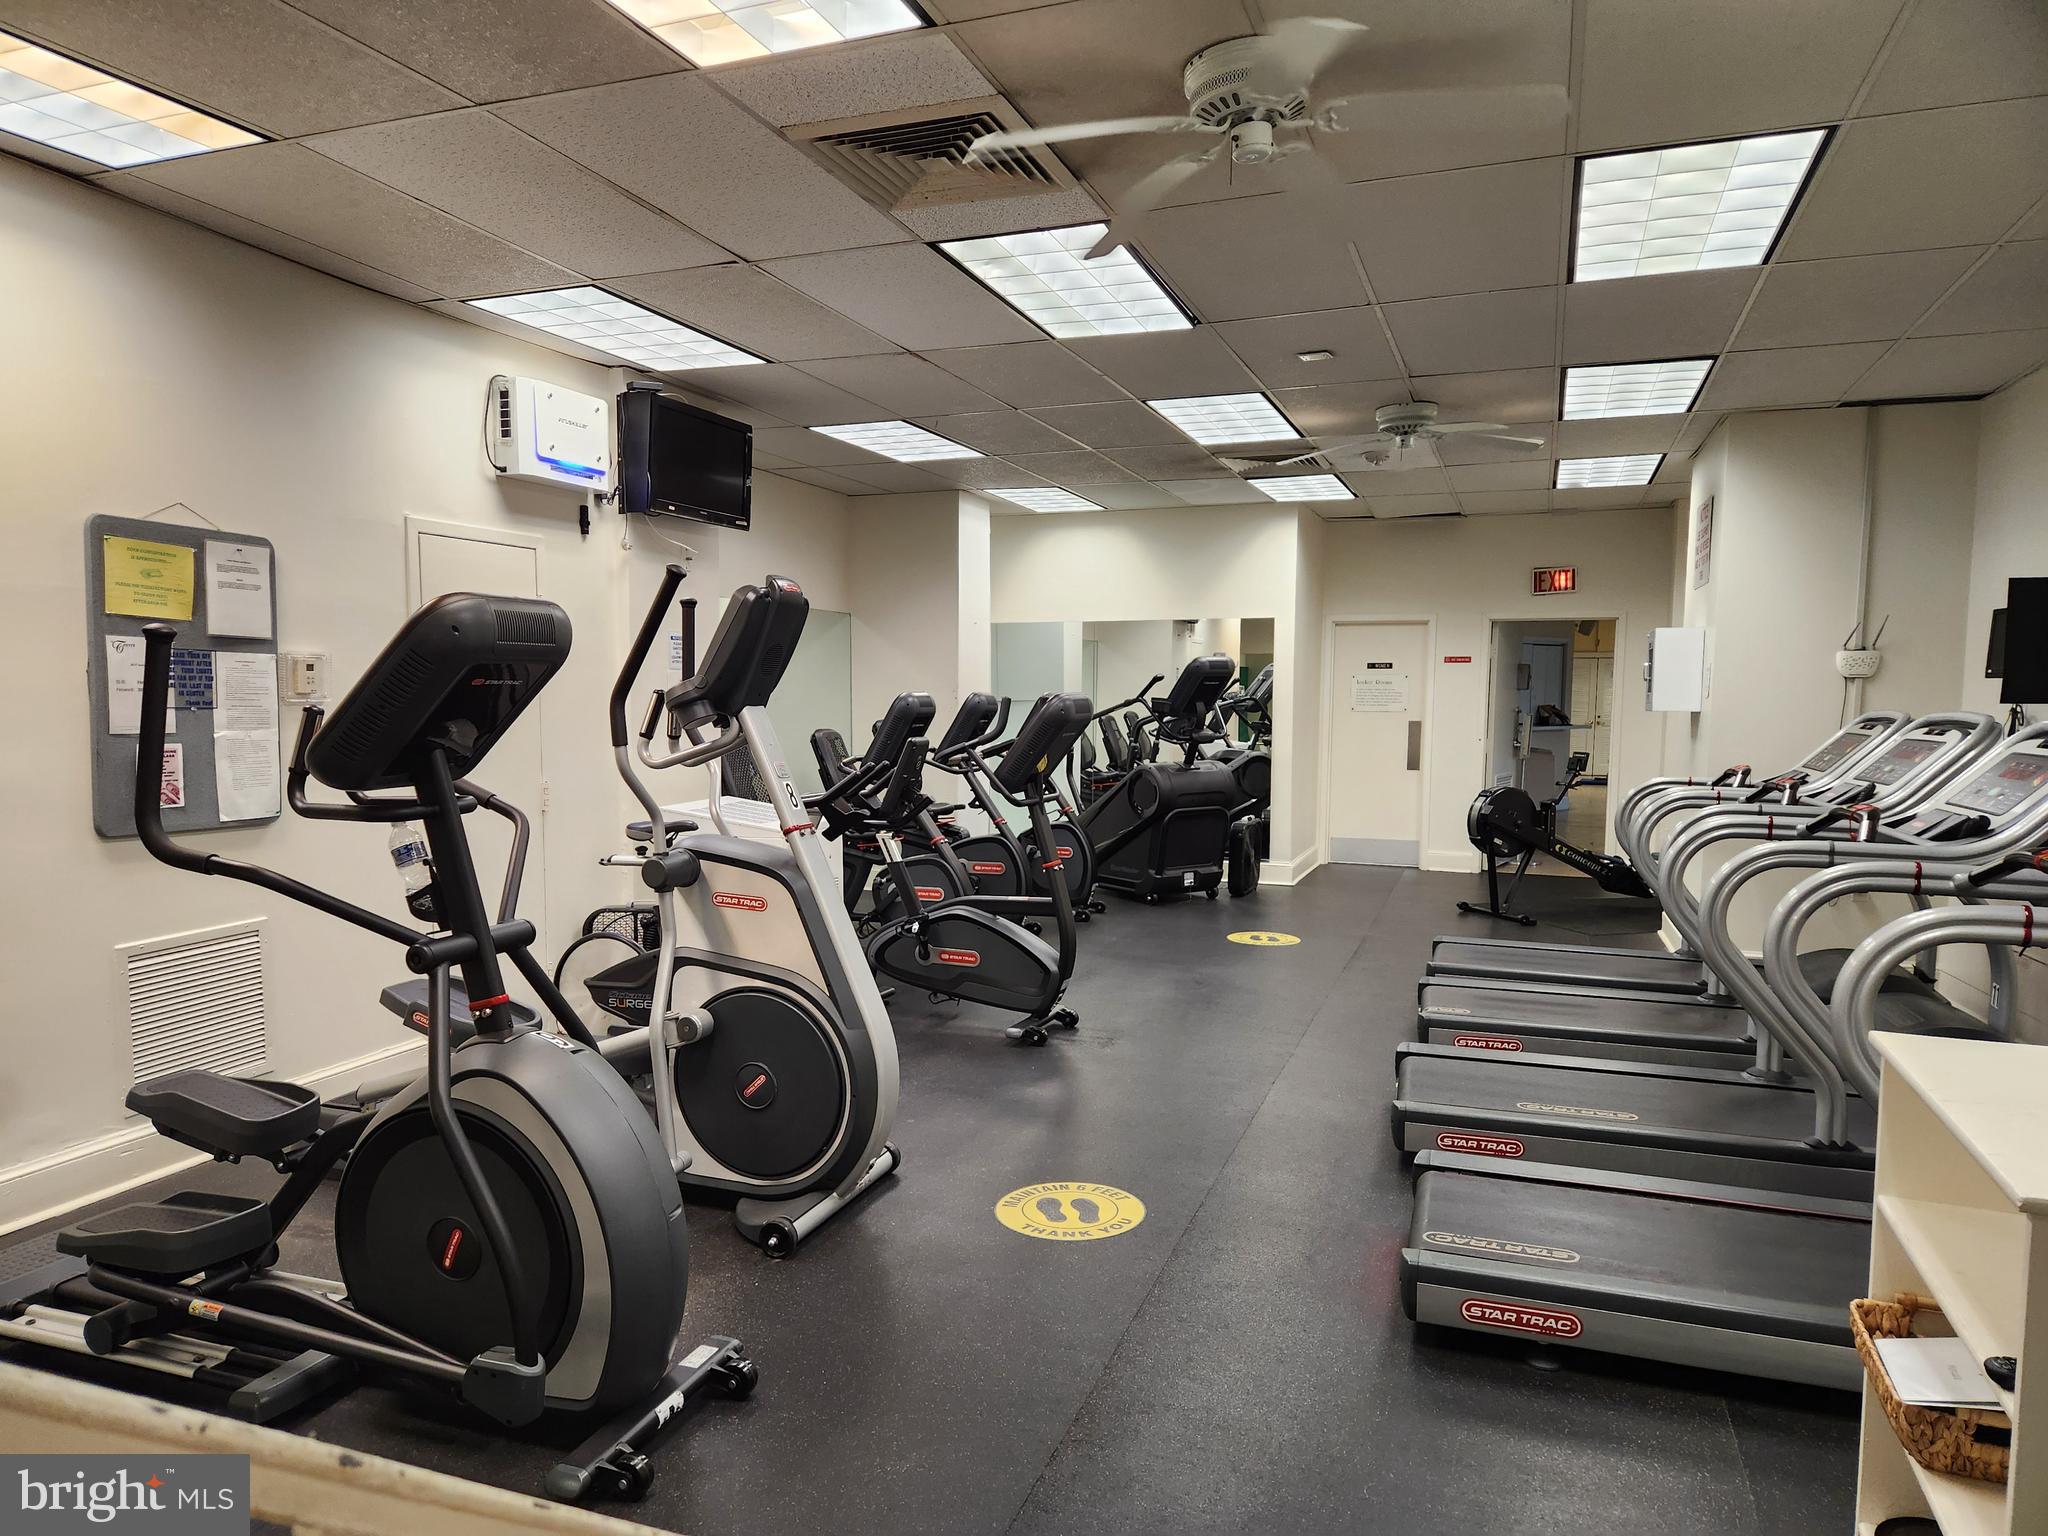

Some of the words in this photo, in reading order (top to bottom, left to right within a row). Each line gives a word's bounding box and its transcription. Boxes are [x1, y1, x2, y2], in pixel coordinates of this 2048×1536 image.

[1538, 569, 1571, 592] EXIT
[786, 783, 799, 809] 8
[716, 896, 739, 905] STAR
[740, 899, 763, 907] TRAC
[609, 998, 652, 1009] SURGE
[1457, 1039, 1486, 1048] STAR
[1487, 1041, 1518, 1050] TRAC
[1441, 1137, 1478, 1149] STAR
[1480, 1141, 1518, 1153] TRAC
[1002, 1183, 1070, 1208] MAINTAIN
[1091, 1186, 1132, 1201] FEET
[1022, 1223, 1094, 1238] THANK
[1098, 1217, 1133, 1234] YOU
[1433, 1234, 1501, 1250] TRAC
[1503, 1243, 1570, 1259] STAR
[1467, 1306, 1518, 1323] STAR
[1520, 1313, 1573, 1331] TRAC
